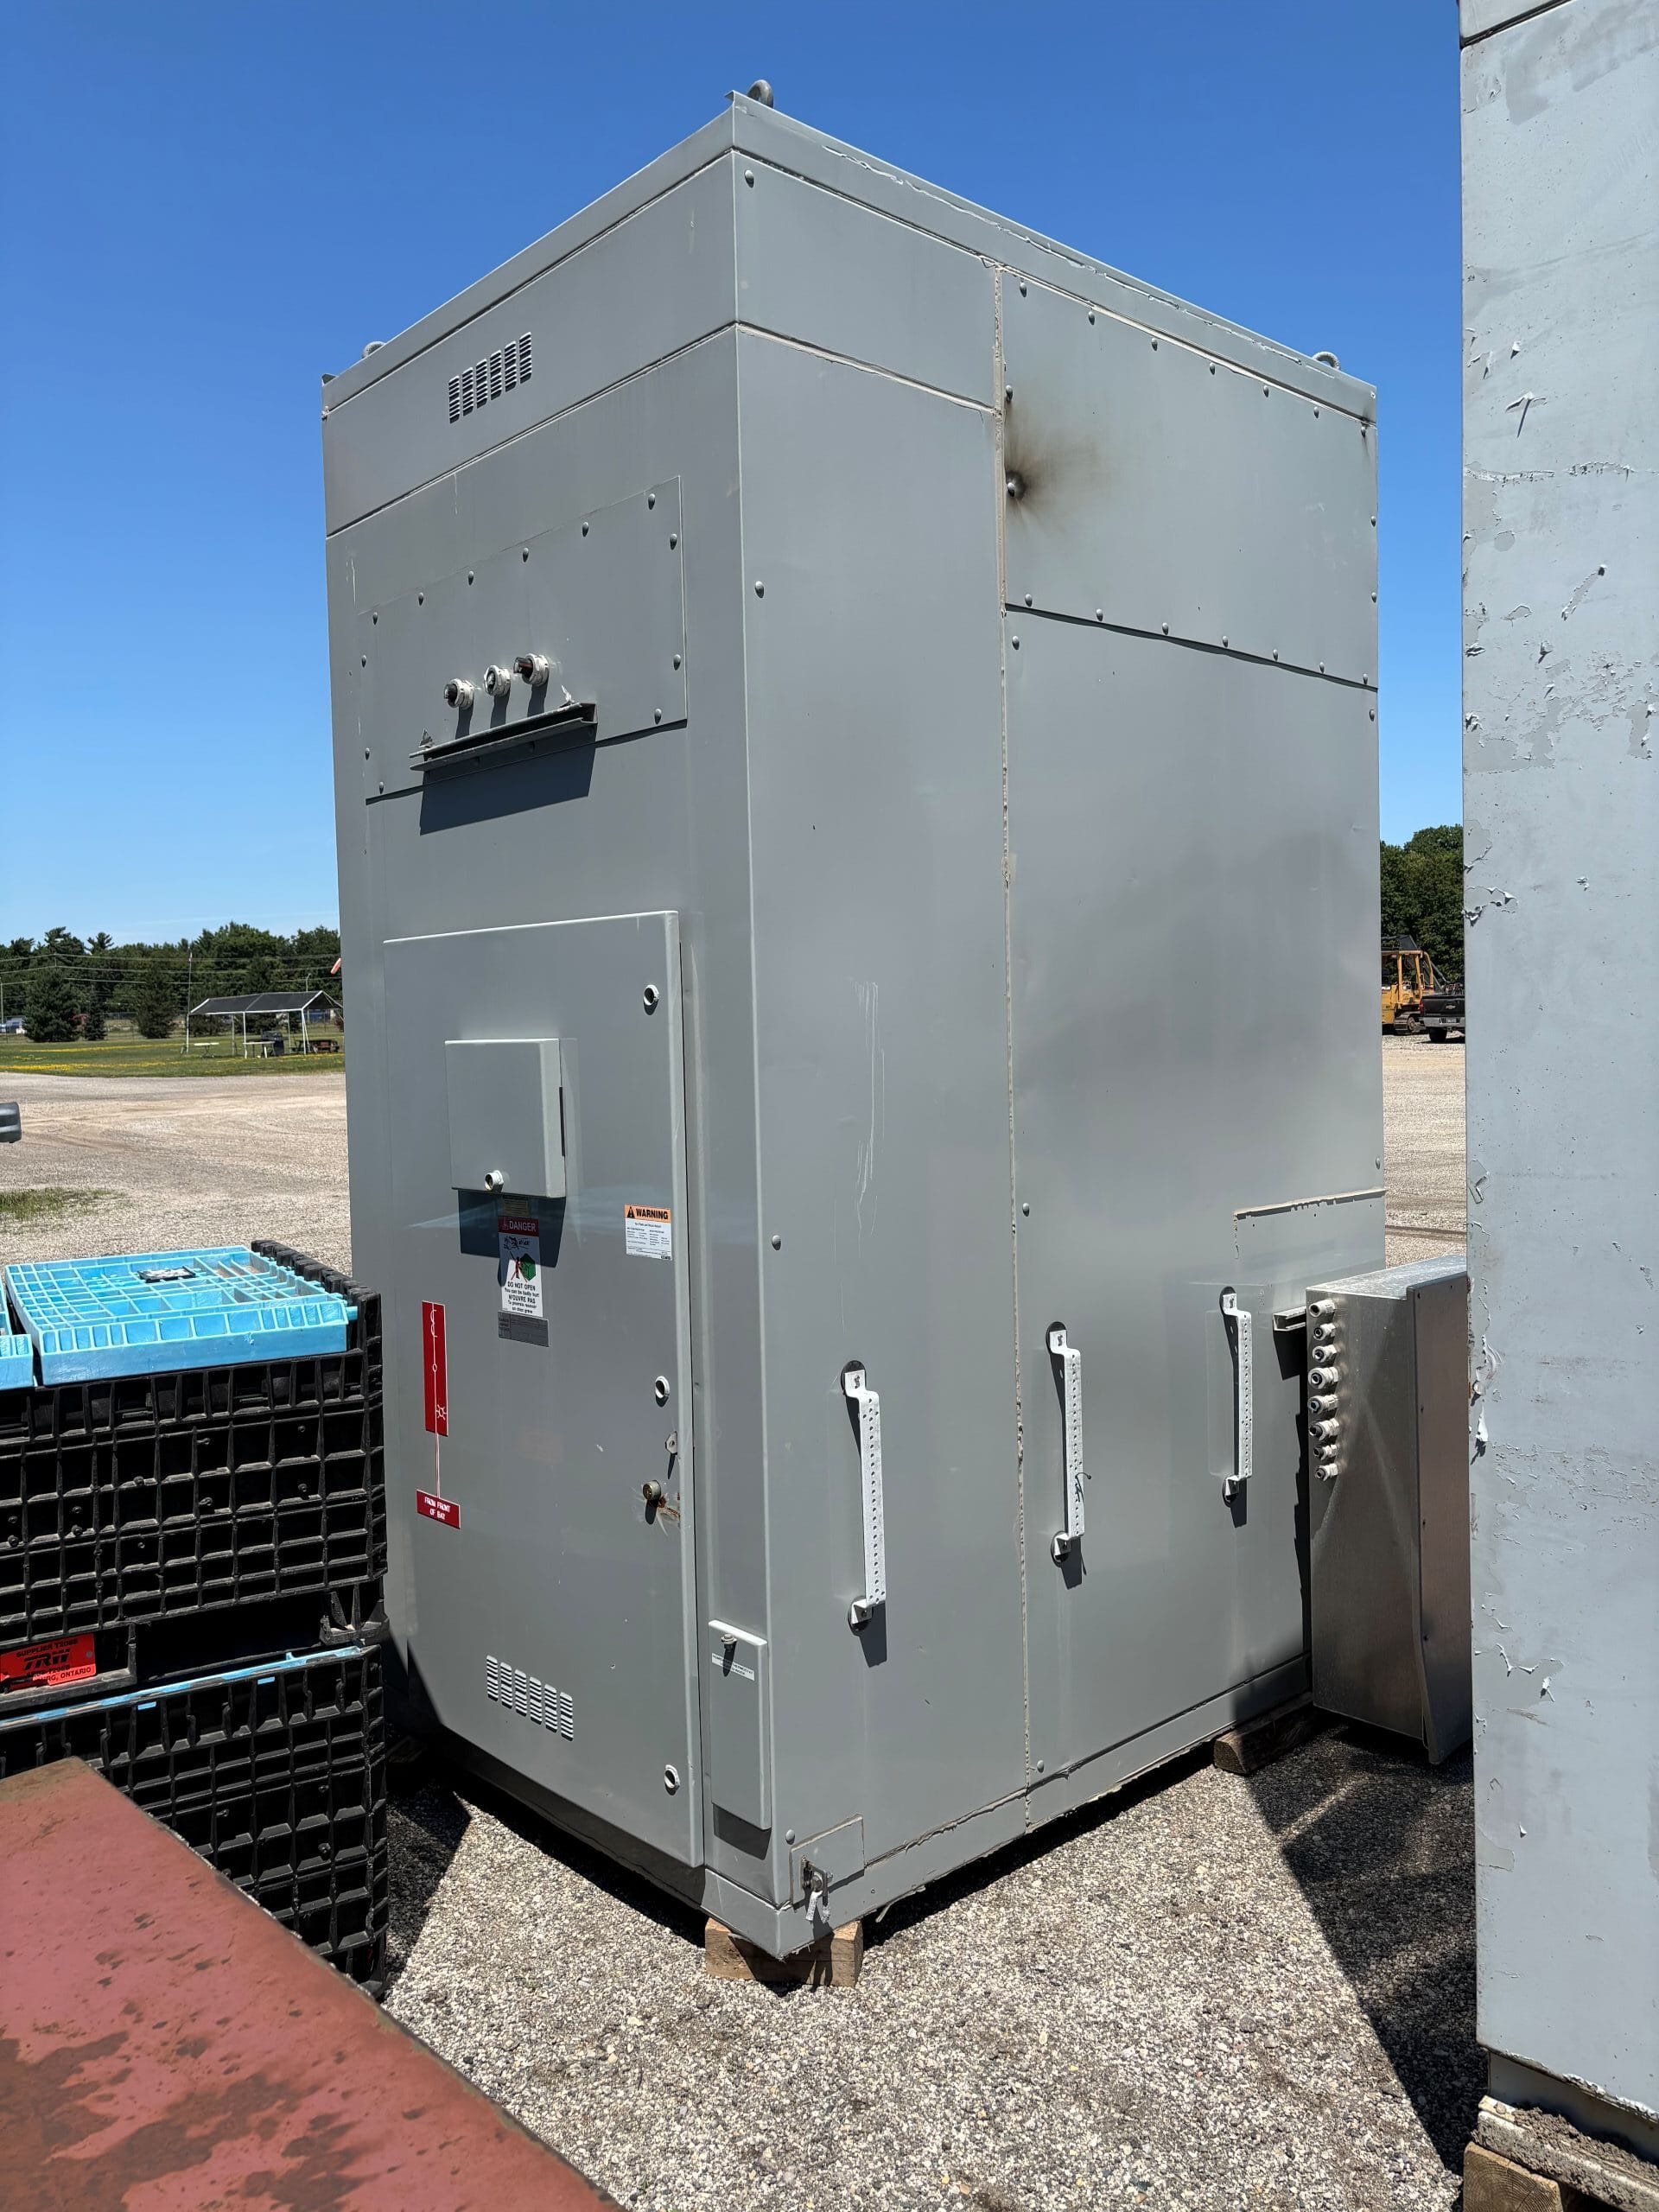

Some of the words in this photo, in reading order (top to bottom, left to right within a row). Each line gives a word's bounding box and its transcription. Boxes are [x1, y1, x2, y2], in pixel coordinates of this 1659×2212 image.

[636, 1208, 669, 1219] WARNING
[509, 1220, 537, 1232] DANGER
[16, 1643, 53, 1657] SUPPLIER
[60, 1667, 92, 1679] ONTARIO
